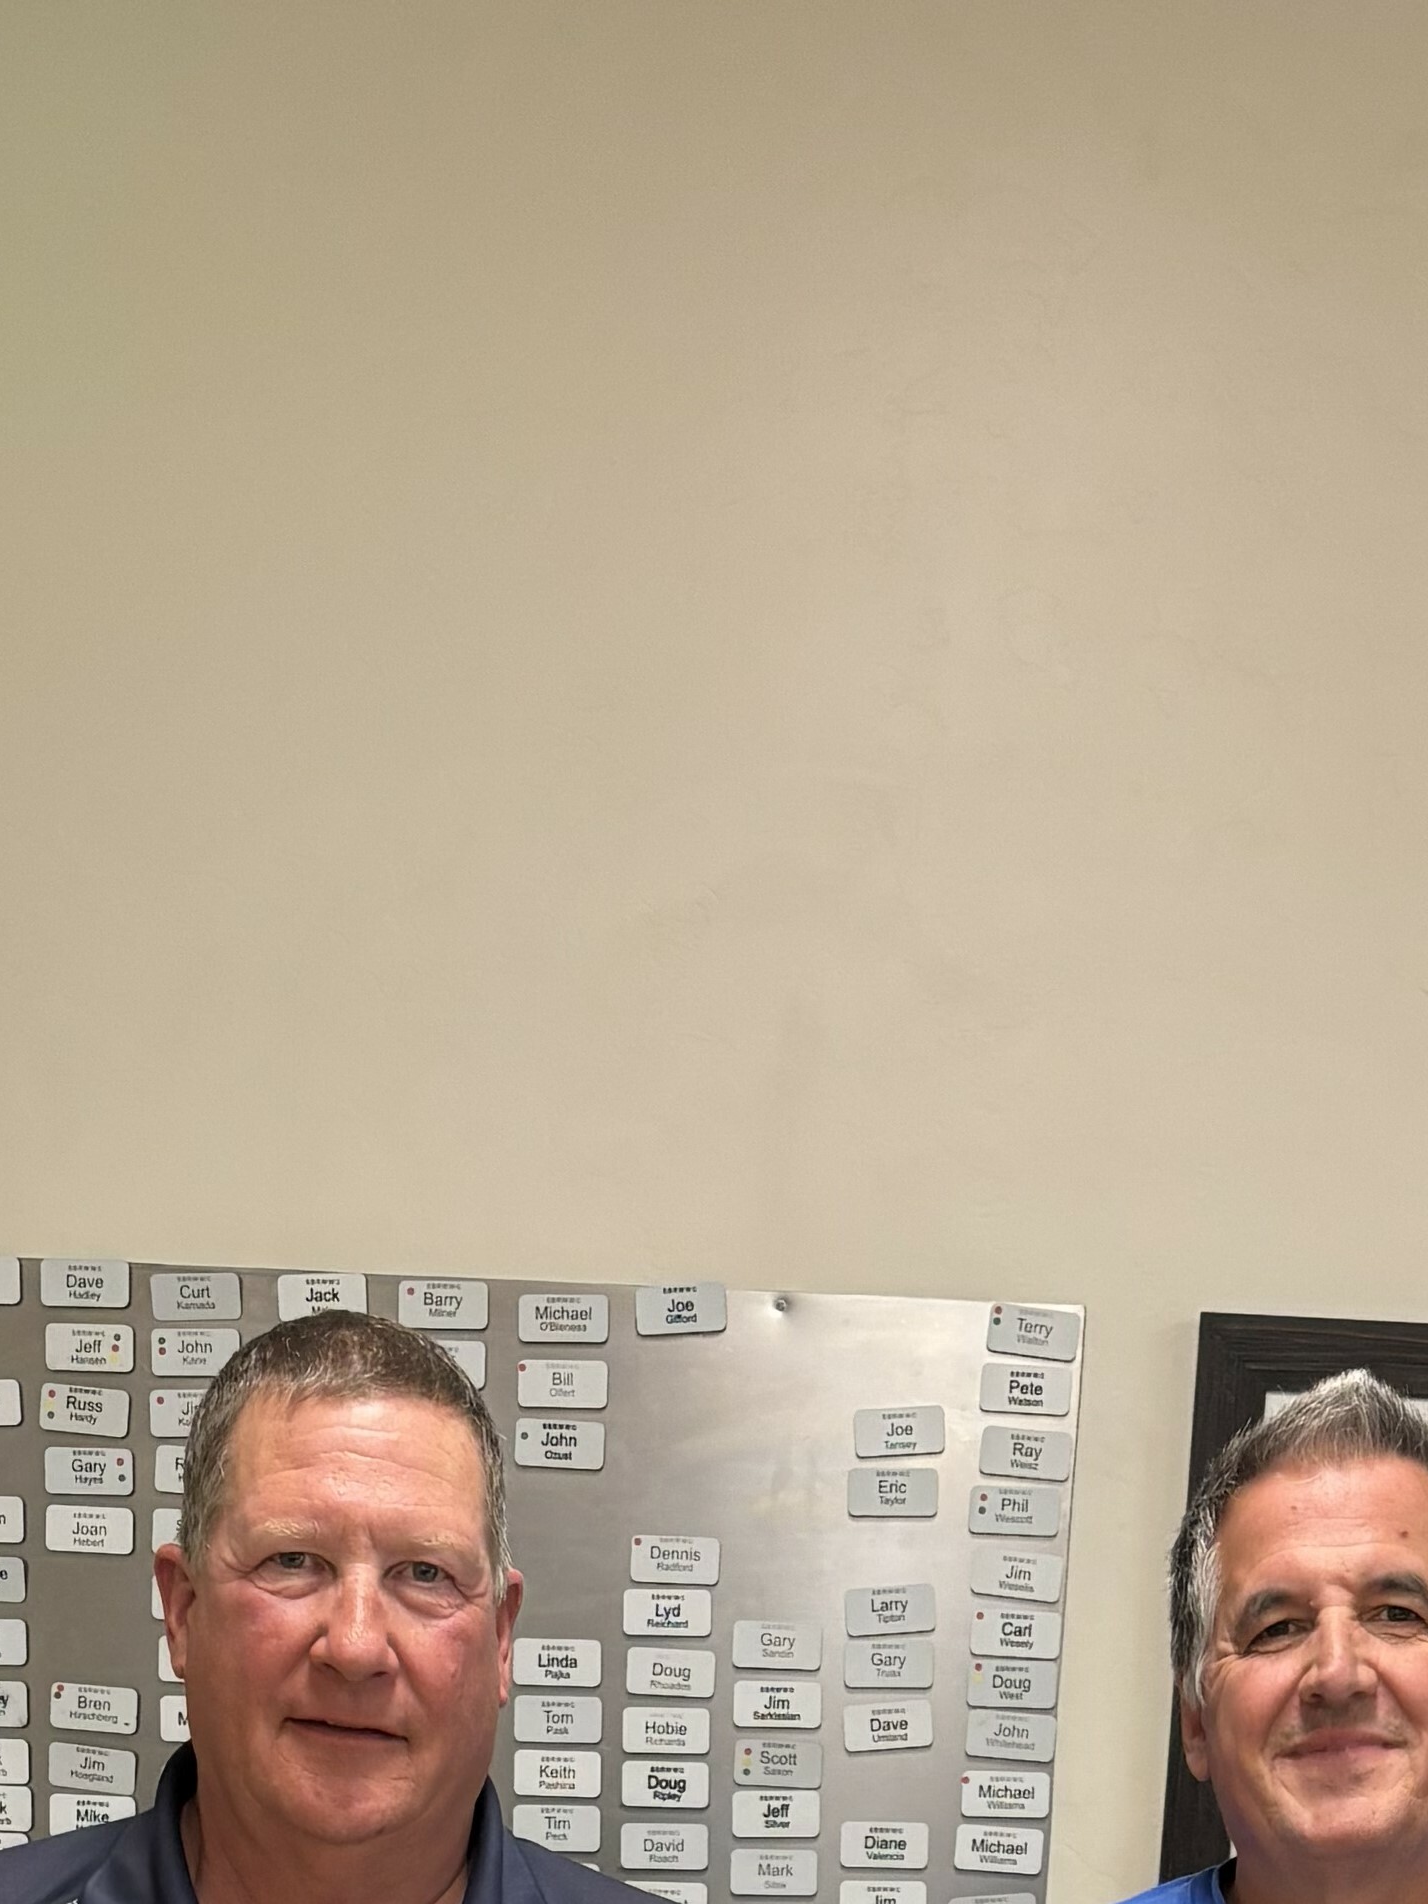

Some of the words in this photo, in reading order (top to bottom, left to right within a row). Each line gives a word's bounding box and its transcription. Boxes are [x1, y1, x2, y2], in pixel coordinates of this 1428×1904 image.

[66, 1275, 104, 1289] Dave
[179, 1285, 211, 1299] Curt
[306, 1288, 340, 1303] Jack
[423, 1292, 463, 1310] Barry
[667, 1299, 694, 1313] Joe
[535, 1306, 593, 1321] Michael
[1017, 1318, 1054, 1339] Terry
[75, 1340, 102, 1353] Jeff
[177, 1340, 213, 1354] John
[552, 1372, 574, 1386] Bill
[1009, 1380, 1044, 1396] Pete
[66, 1396, 103, 1413] Russ
[887, 1423, 913, 1437] Joe
[541, 1433, 577, 1447] John
[1012, 1442, 1043, 1462] Ray
[72, 1459, 106, 1476] Gary
[878, 1480, 907, 1494] Eric
[1001, 1498, 1029, 1512] Phil
[72, 1522, 107, 1537] Joan
[650, 1545, 701, 1562] Dennis
[1005, 1566, 1031, 1581] Jim
[655, 1603, 681, 1620] Lyd
[871, 1598, 909, 1614] Larry
[1001, 1622, 1032, 1637] Carl
[760, 1633, 795, 1650] Gary
[538, 1654, 578, 1669] Linda
[871, 1653, 906, 1669] Gary
[652, 1663, 691, 1681] Doug
[992, 1675, 1031, 1693] Doug
[78, 1696, 111, 1712] Bren
[764, 1696, 790, 1710] Jim
[544, 1711, 574, 1724] Tom
[870, 1718, 909, 1732] Dave
[645, 1721, 687, 1736] Hobie
[994, 1723, 1029, 1740] John
[80, 1757, 105, 1772] Jim
[760, 1751, 797, 1766] Scott
[539, 1765, 576, 1779] Keith
[647, 1775, 687, 1793] Doug
[978, 1785, 1035, 1799] Michael
[76, 1809, 110, 1823] Mike
[763, 1804, 790, 1818] Jeff
[545, 1816, 571, 1830] Tim
[644, 1839, 685, 1852] David
[865, 1836, 907, 1850] Diane
[971, 1839, 1028, 1855] Michael
[758, 1863, 793, 1877] Mark
